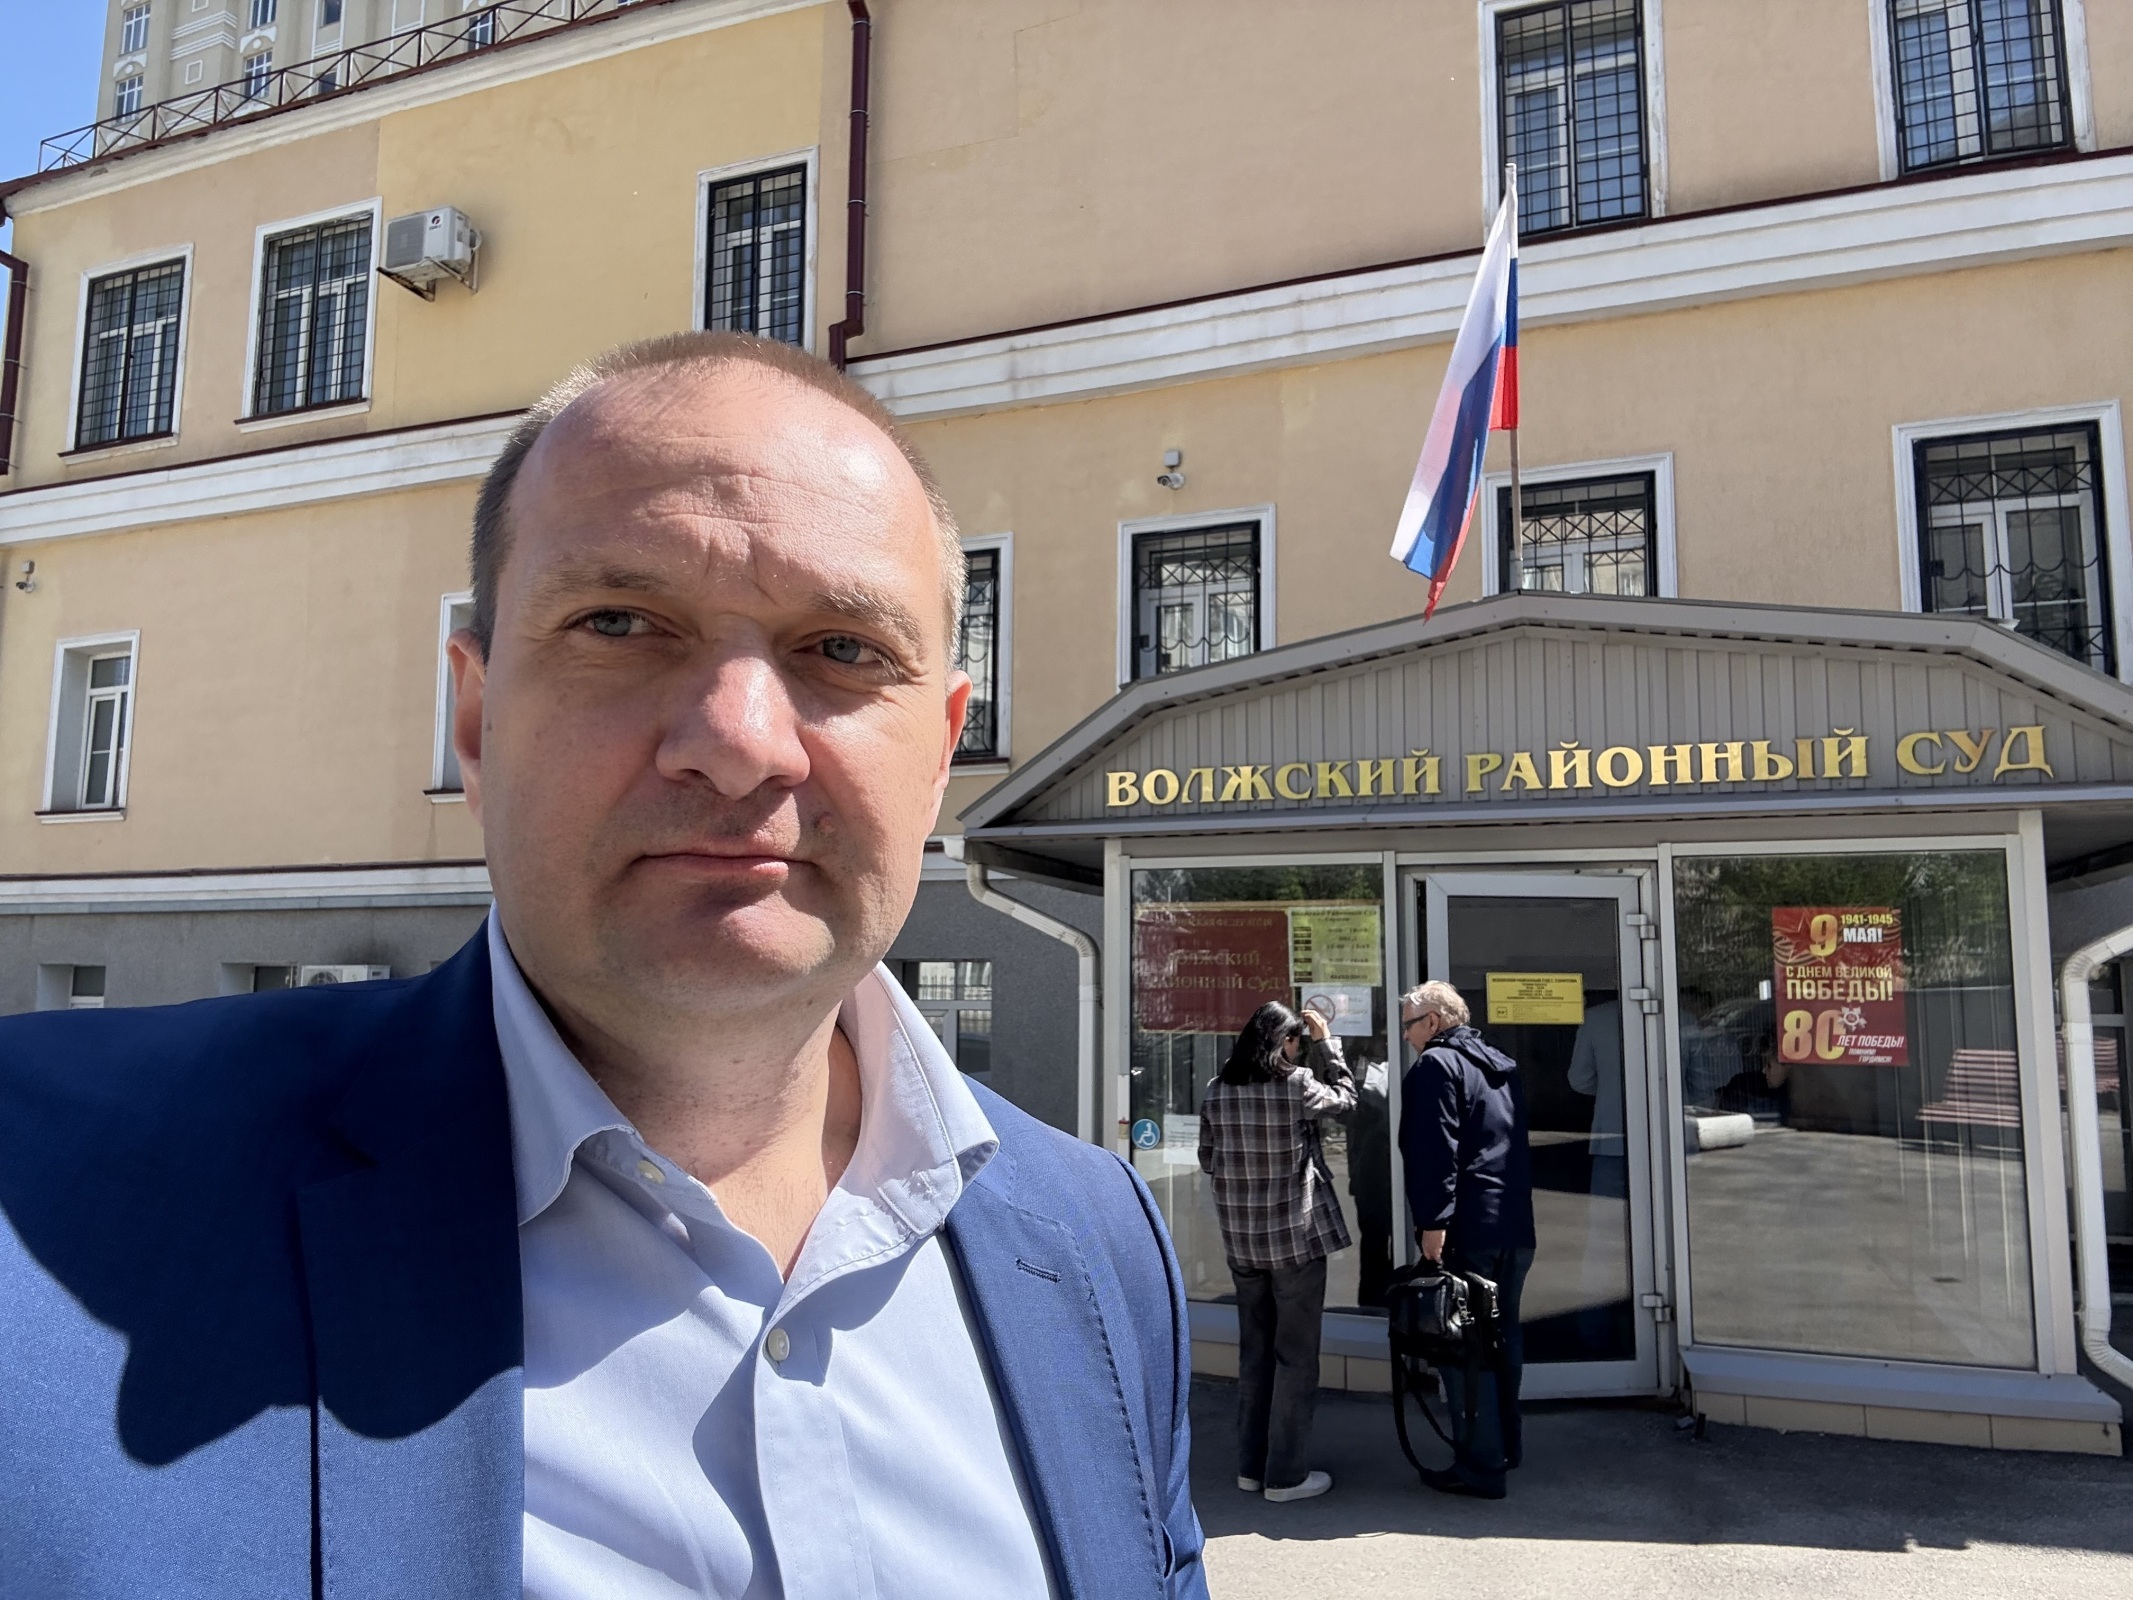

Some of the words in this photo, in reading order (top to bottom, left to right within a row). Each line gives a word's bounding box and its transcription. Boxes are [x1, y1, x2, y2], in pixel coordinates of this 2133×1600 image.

[1106, 748, 1442, 808] ВОЛЖСКИЙ
[1464, 727, 1870, 793] РАЙОННЫЙ
[1896, 725, 2054, 783] СУД
[1841, 914, 1893, 925] 1941-1945
[1809, 914, 1838, 957] 9
[1843, 927, 1884, 943] МАЯ!
[1786, 966, 1795, 977] С
[1835, 965, 1893, 979] ВЕЛИКОЙ
[1786, 979, 1893, 1003] ПОБЕДЫ!
[1782, 1009, 1847, 1060] 80
[1837, 1034, 1857, 1046] ЛЕТ
[1857, 1035, 1905, 1049] ПОБЕДЫ!
